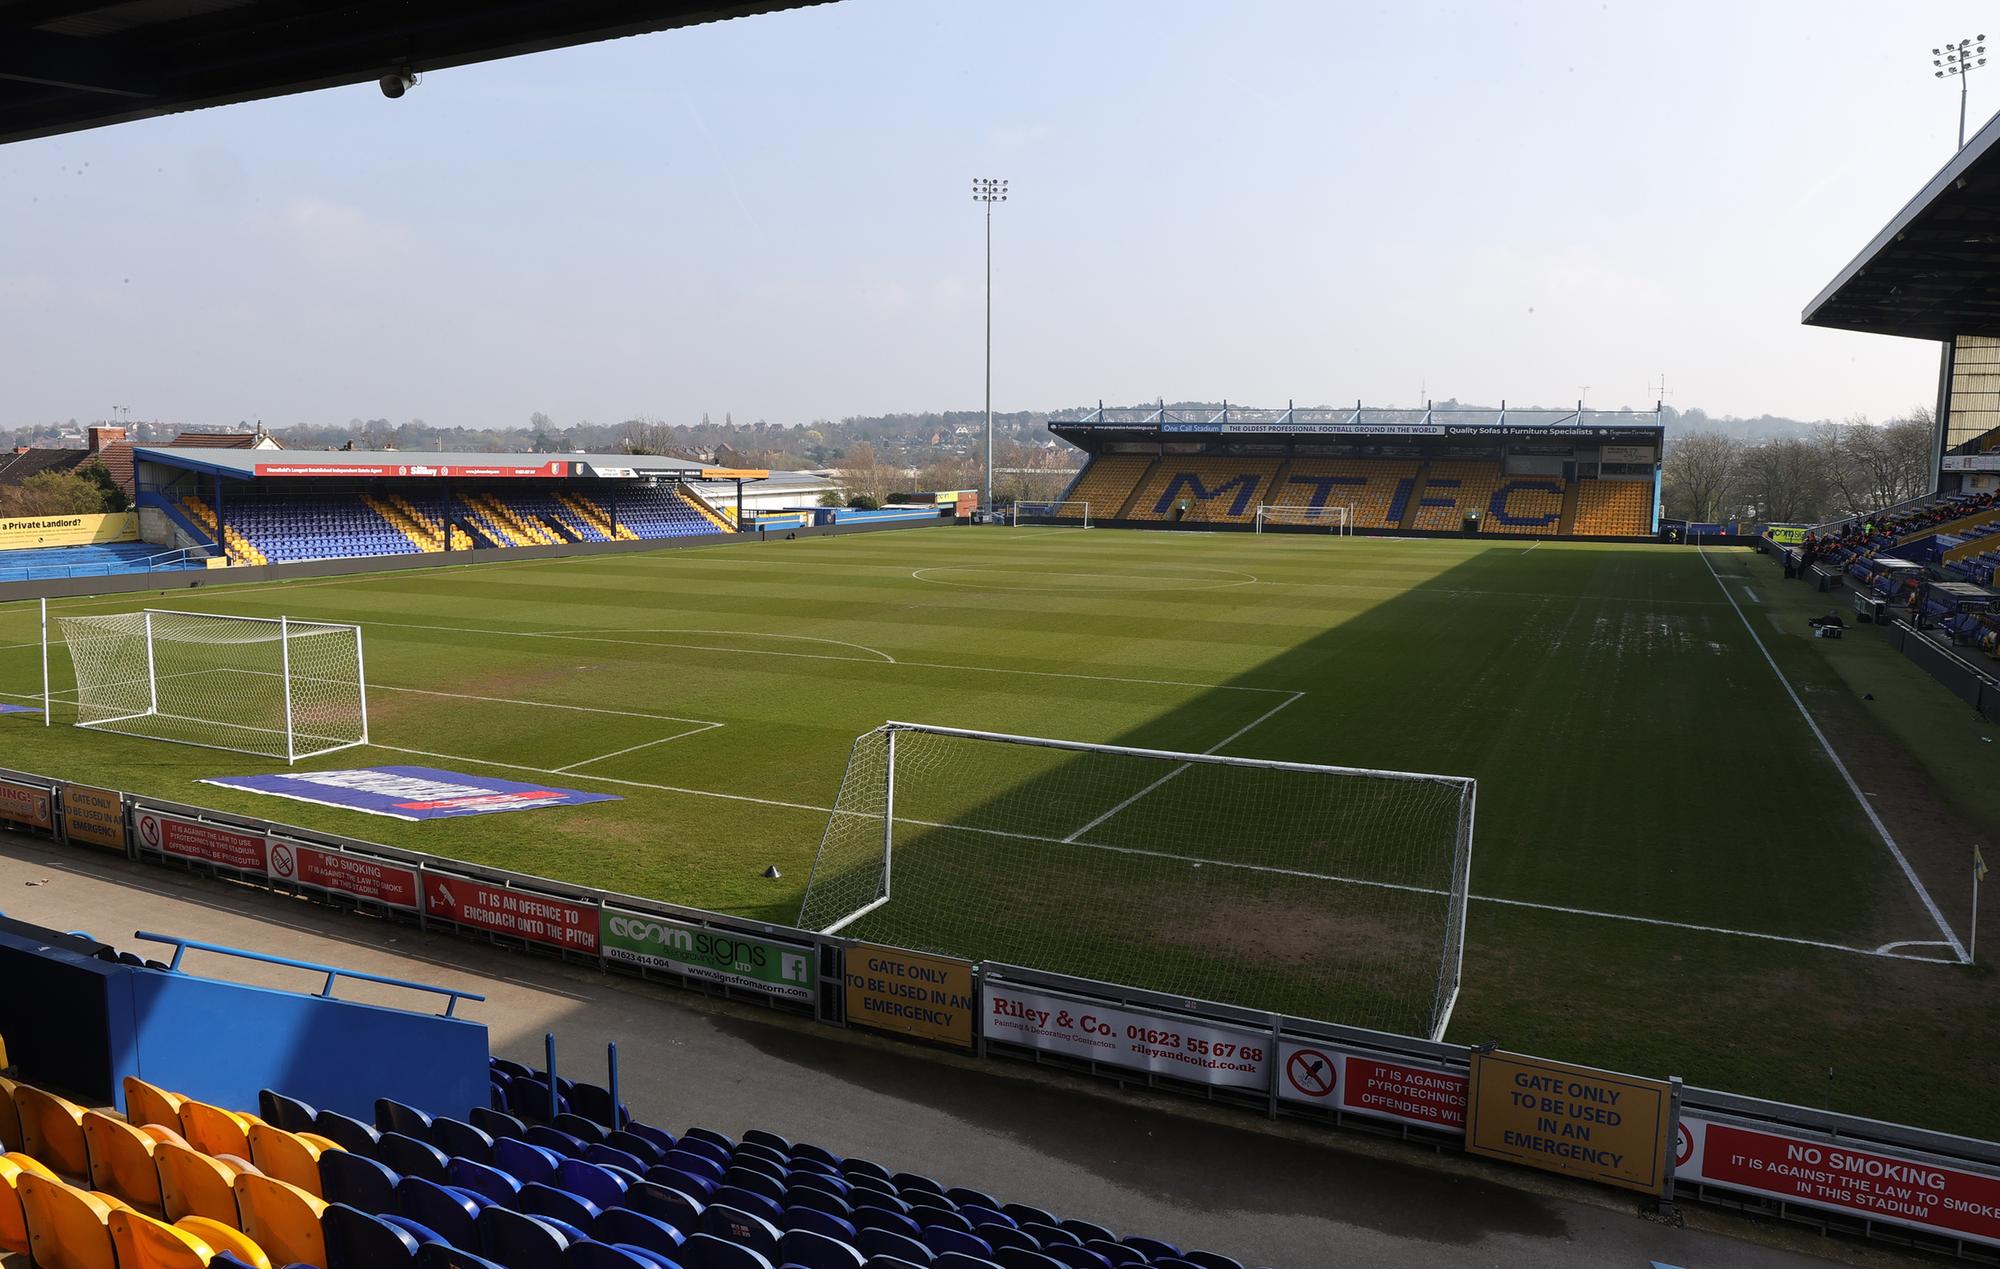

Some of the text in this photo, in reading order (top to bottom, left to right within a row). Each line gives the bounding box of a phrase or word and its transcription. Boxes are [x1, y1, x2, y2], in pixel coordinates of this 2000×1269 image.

[1180, 424, 1192, 432] Call
[1450, 427, 1477, 435] Quality
[1550, 428, 1593, 436] Specialists
[9, 521, 41, 530] Private
[42, 518, 82, 528] Landlord?
[0, 787, 31, 802] ING!
[72, 793, 111, 808] GATE ONLY
[73, 808, 84, 816] BE
[85, 810, 102, 820] USED
[103, 813, 112, 822] IN
[73, 821, 116, 838] EMERGENCY
[170, 833, 208, 846] PYROTECHNICS
[216, 842, 228, 850] THIS
[184, 827, 206, 836] AGAINST
[207, 832, 217, 840] THE
[238, 839, 252, 847] USE
[169, 842, 200, 853] OFFENDERS
[201, 848, 212, 857] WILL
[222, 853, 260, 866] PROSECUTED
[325, 856, 381, 877] NO SMOKING
[320, 868, 345, 879] AGAINST
[357, 875, 372, 885] LAW
[381, 881, 402, 892] SMOKE
[340, 880, 351, 888] THIS
[352, 883, 378, 895] STADIUM
[479, 890, 579, 925] IT IS AN OFFENCE TO
[464, 905, 595, 948] ENCROACH ONTO THE PITCH
[609, 916, 766, 967] acorn signs
[611, 949, 669, 968] 01623 414 004
[735, 961, 752, 972] LTD
[868, 958, 948, 984] GATE ONLY
[688, 966, 808, 998] www.signsfromacorn.com
[846, 974, 972, 1010] TO BE USED IN AN
[864, 997, 952, 1026] EMERGENCY
[993, 997, 1117, 1037] Riley & Co.
[994, 1018, 1023, 1031] Painting
[1031, 1026, 1070, 1041] Decorating
[1072, 1034, 1116, 1049] Contractors
[1127, 1025, 1263, 1062] 01623 55 67 68
[1131, 1044, 1257, 1073] rileyandcoltd.co.uk
[1368, 1079, 1466, 1106] PYROTECHNICS
[1375, 1067, 1462, 1093] IT IS AGAINST
[1515, 1072, 1621, 1105] GATE ONLY
[1362, 1093, 1464, 1122] OFFENDERS WIL
[1511, 1091, 1621, 1126] TO BE USED
[1537, 1117, 1590, 1141] IN AN
[1503, 1130, 1623, 1169] EMERGENCY
[1787, 1144, 1946, 1190] NO SMOKING
[1731, 1154, 2000, 1220] IT IS AGAINST THE LAW TO SMOKE
[1796, 1181, 1929, 1219] IN THIS STADIUM
